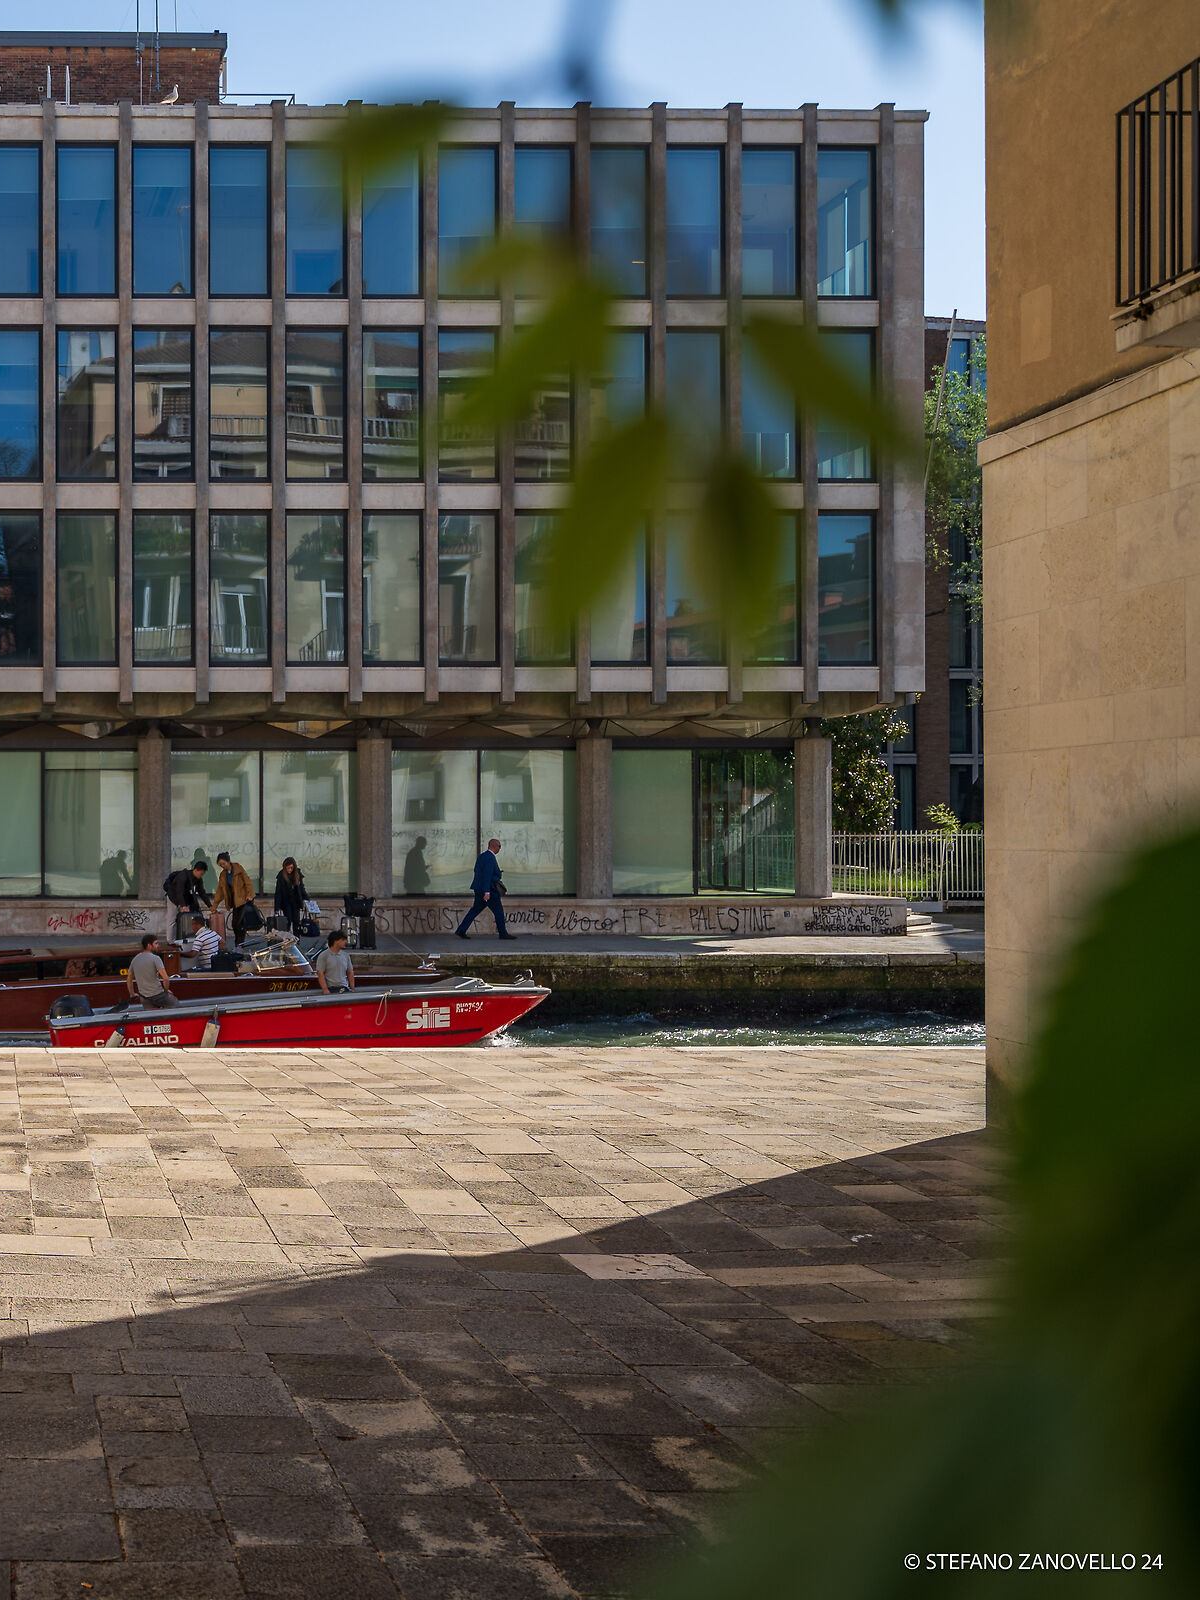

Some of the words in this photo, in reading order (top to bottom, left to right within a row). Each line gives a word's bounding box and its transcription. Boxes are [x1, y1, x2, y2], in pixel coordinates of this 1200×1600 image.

[375, 907, 481, 934] STRAGIST
[503, 908, 546, 924] uanito
[689, 906, 776, 934] PALESTINE
[94, 1035, 179, 1048] CALLINO
